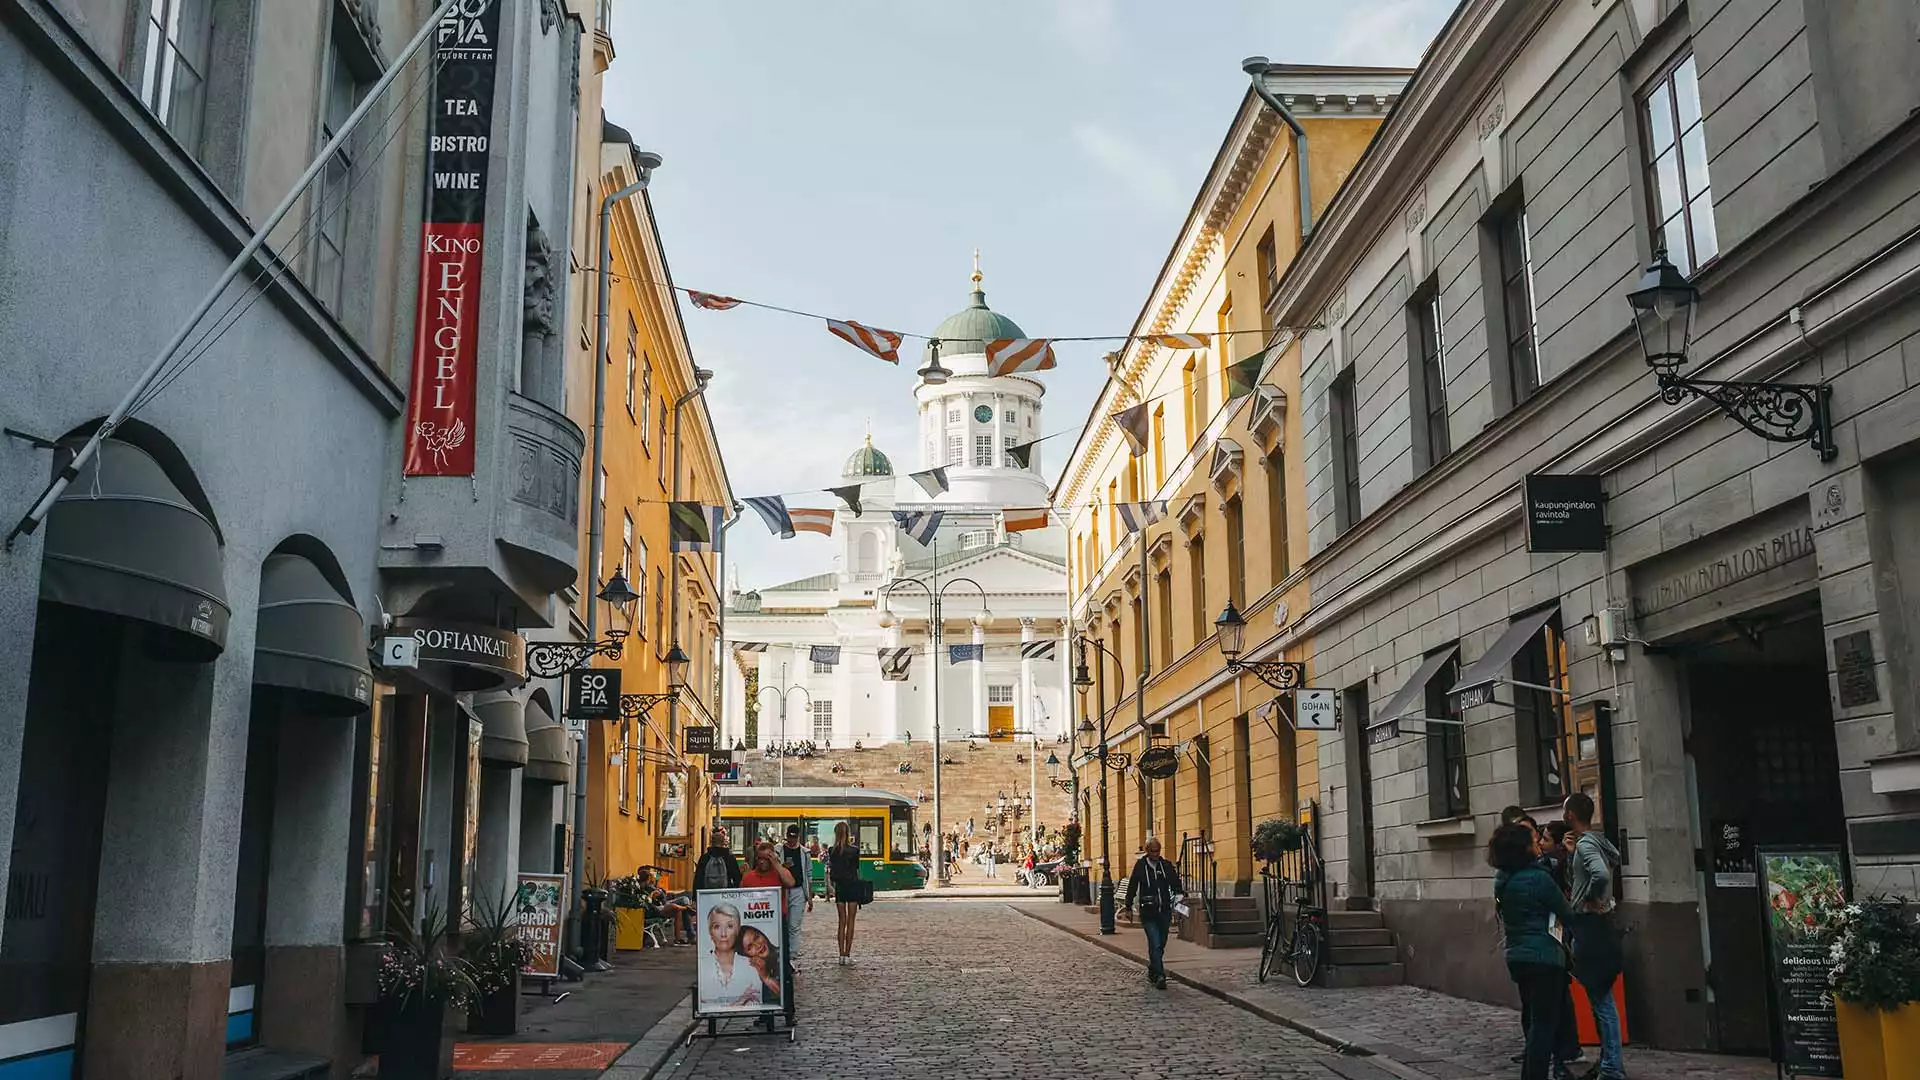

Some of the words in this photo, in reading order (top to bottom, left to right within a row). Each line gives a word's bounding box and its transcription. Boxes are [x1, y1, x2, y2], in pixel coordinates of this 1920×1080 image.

[438, 18, 488, 44] FIA
[437, 52, 469, 60] FUTURE
[471, 52, 493, 60] FARM
[444, 99, 479, 115] TEA
[430, 135, 488, 152] BISTRO
[434, 172, 480, 189] WINE
[433, 262, 466, 409] ENGEL
[1535, 500, 1596, 510] kaupungintalon
[391, 643, 403, 660] C
[581, 674, 607, 690] SO
[580, 690, 608, 705] FIA
[1461, 687, 1484, 710] GOHAN
[1301, 702, 1330, 711] GOHAN
[711, 757, 730, 765] OKRA
[748, 901, 771, 910] LATE
[517, 927, 551, 941] UNCH
[1782, 956, 1821, 965] delicious
[1788, 1014, 1829, 1022] herkullinen
